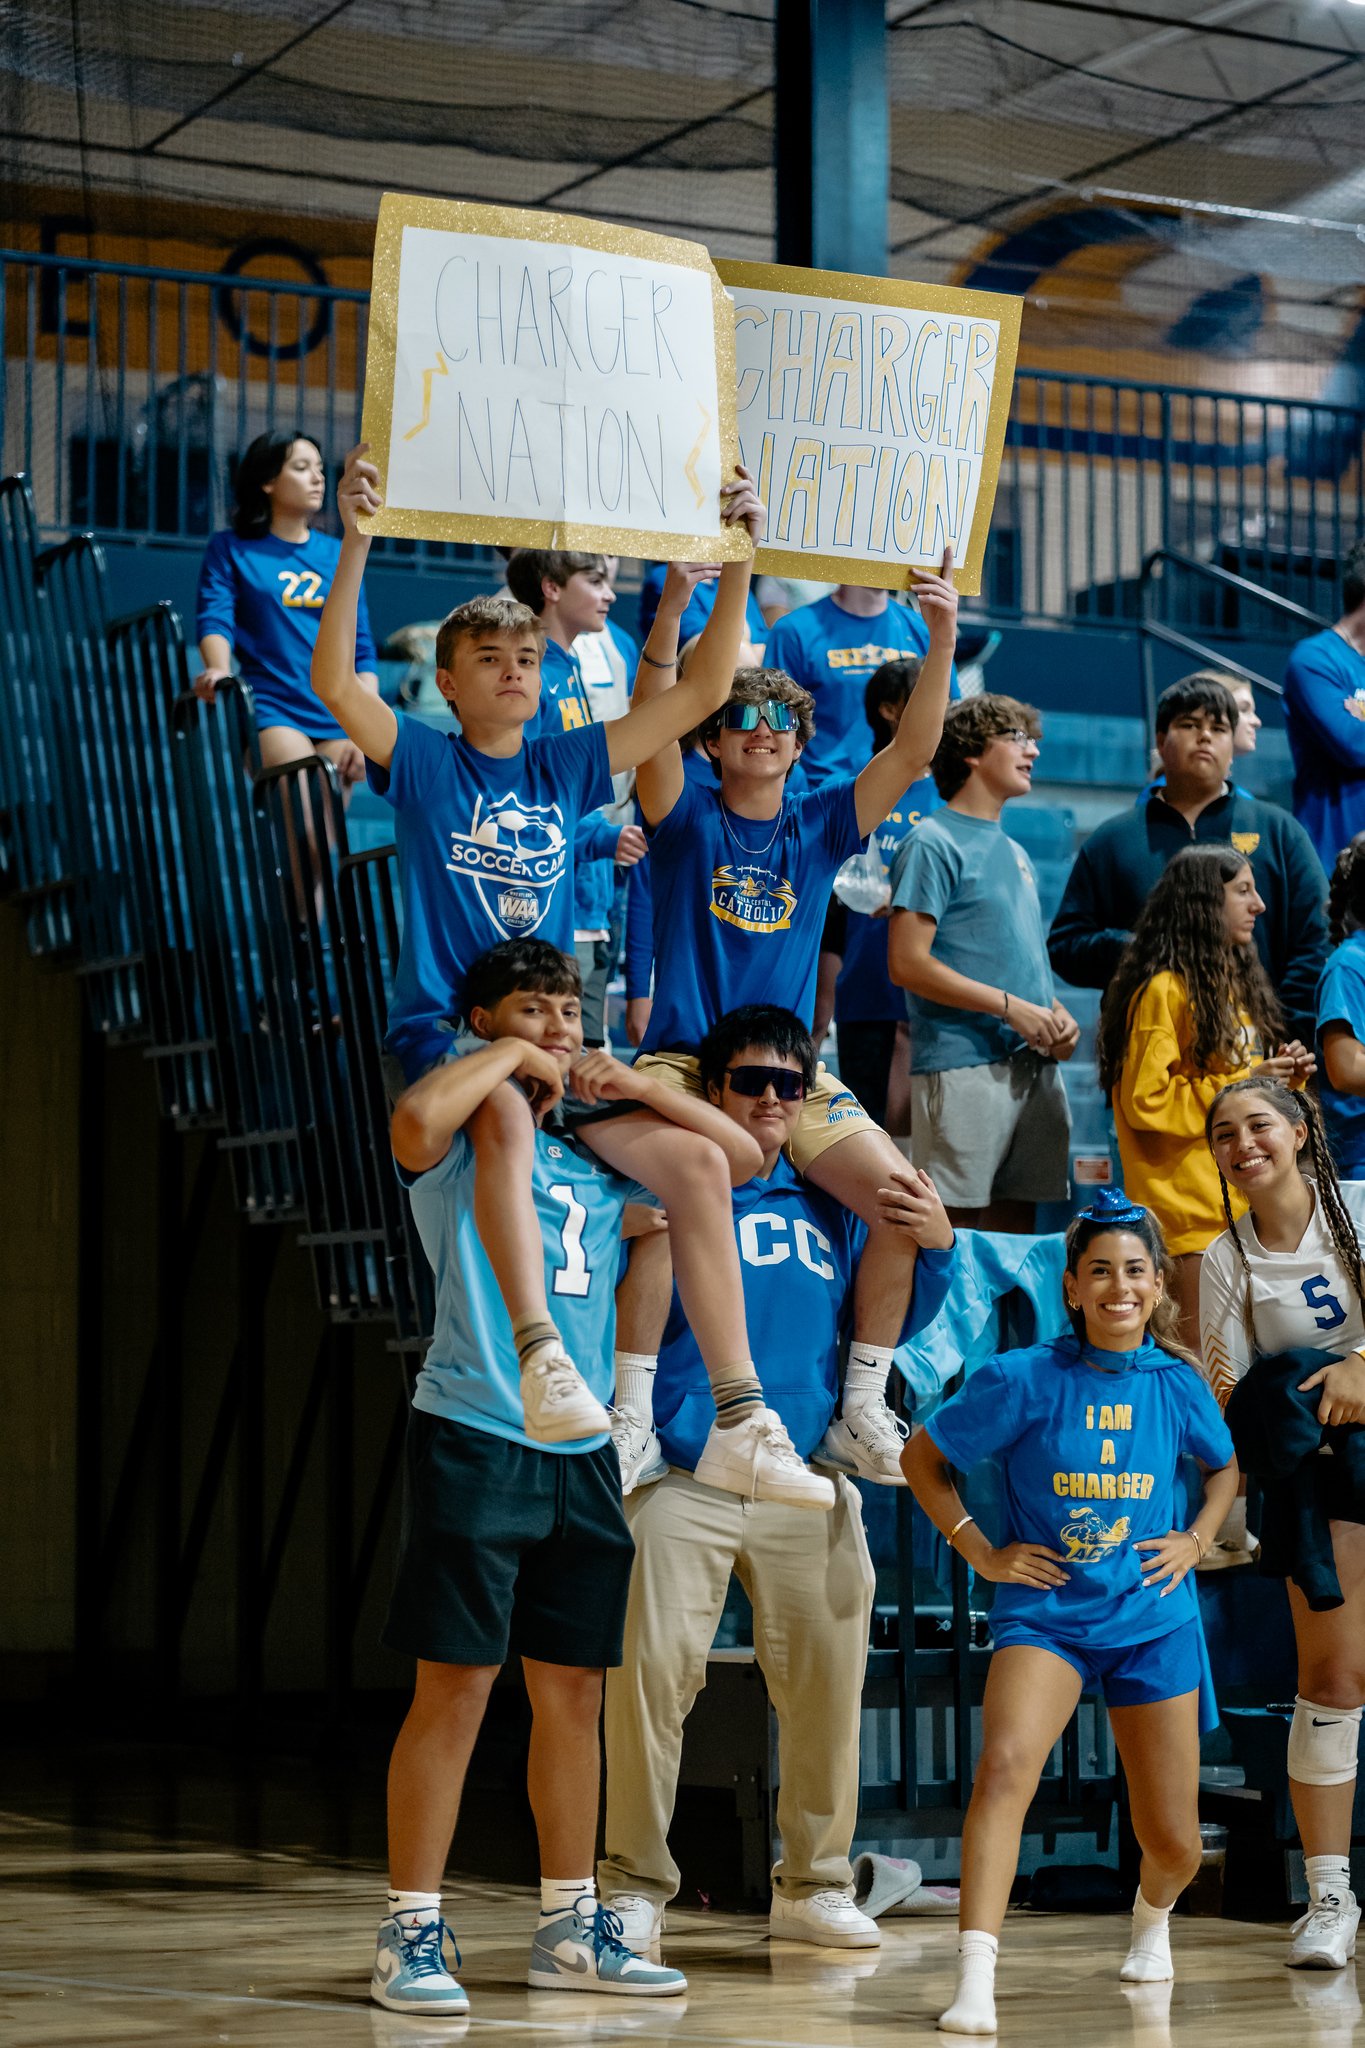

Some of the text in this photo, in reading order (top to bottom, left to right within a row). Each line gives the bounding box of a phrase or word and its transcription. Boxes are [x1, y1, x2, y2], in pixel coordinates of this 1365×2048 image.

[435, 255, 683, 382] CHARGER
[735, 304, 998, 455] CHARGER
[458, 391, 667, 518] NATION
[278, 571, 325, 608] 22
[451, 844, 533, 878] SOCCER
[498, 894, 540, 921] WAA
[547, 1182, 592, 1298] 1
[739, 1212, 835, 1280] CC
[1086, 1404, 1132, 1431] I AM
[1100, 1439, 1116, 1465] A
[1053, 1472, 1155, 1500] CHARGER
